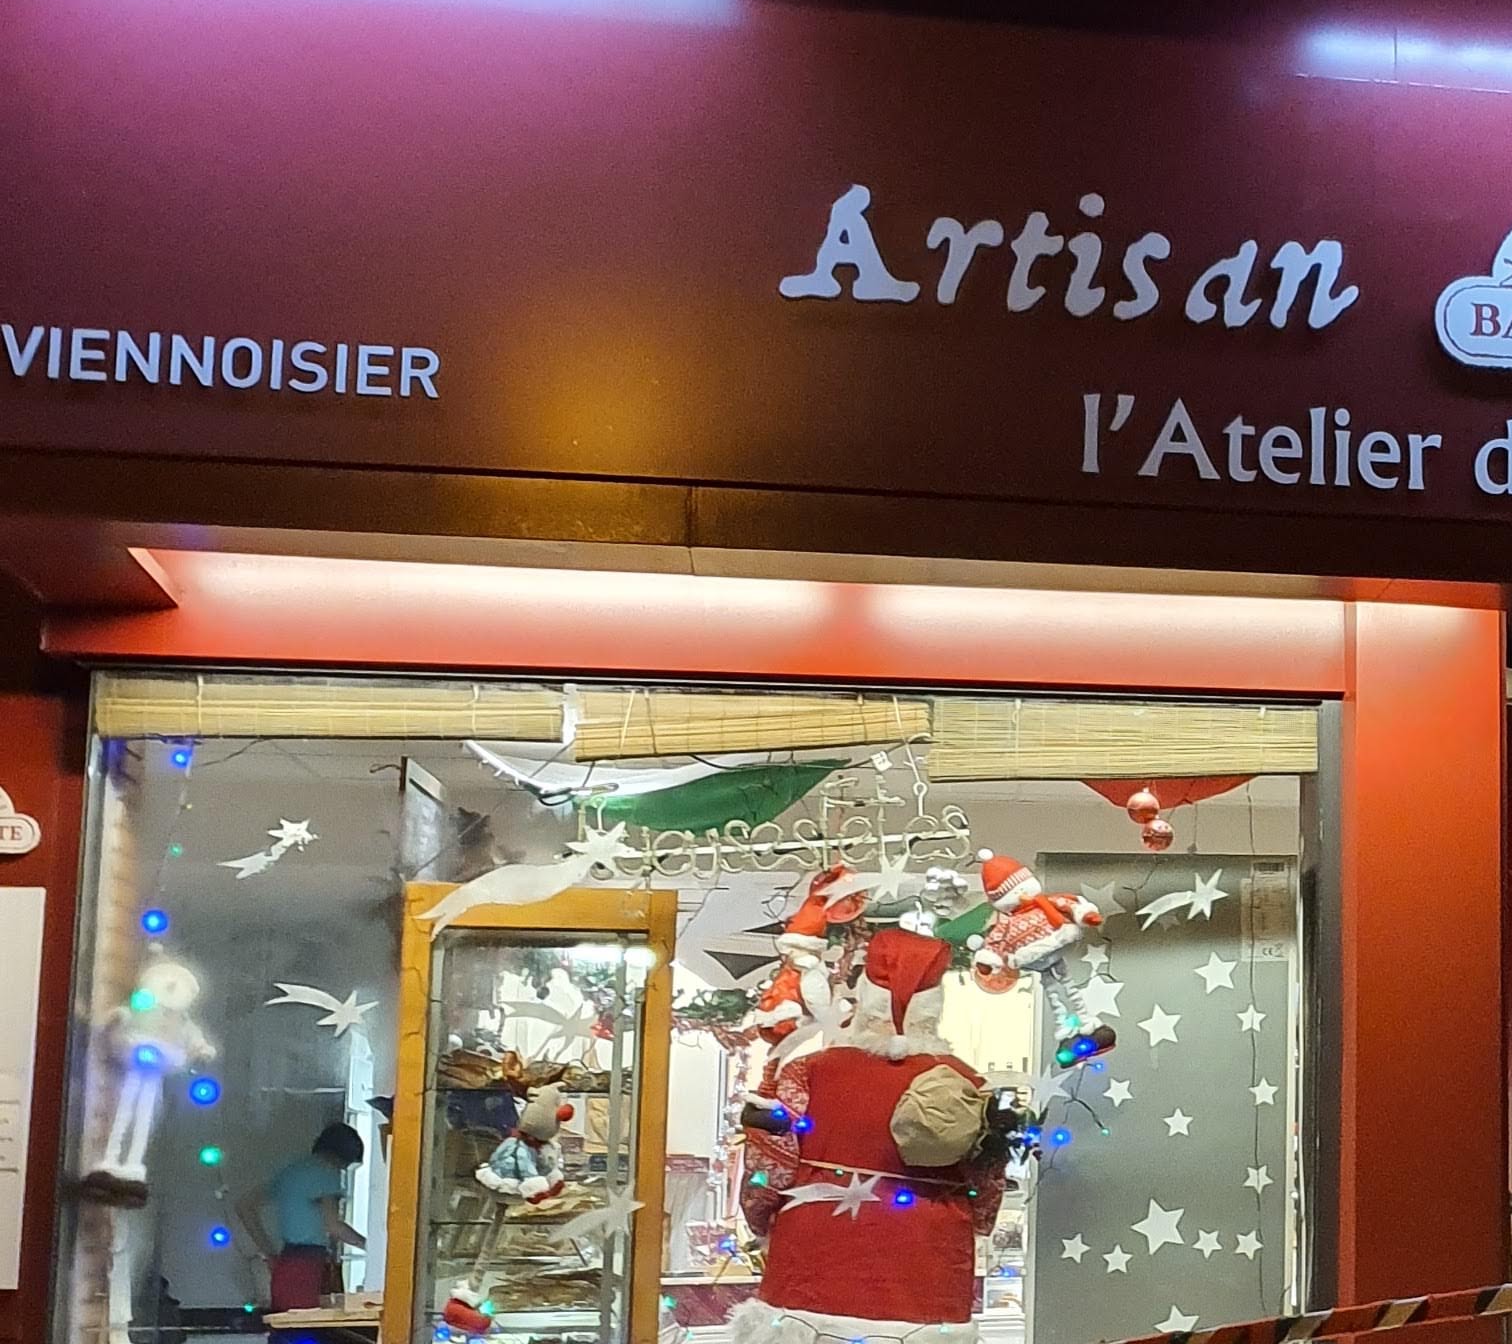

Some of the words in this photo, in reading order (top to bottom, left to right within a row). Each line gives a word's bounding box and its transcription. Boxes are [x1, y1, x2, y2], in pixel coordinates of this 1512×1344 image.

[779, 184, 1358, 329] Artisan
[0, 323, 440, 399] VIENNOISIER
[1082, 393, 1442, 490] l'Atelier
